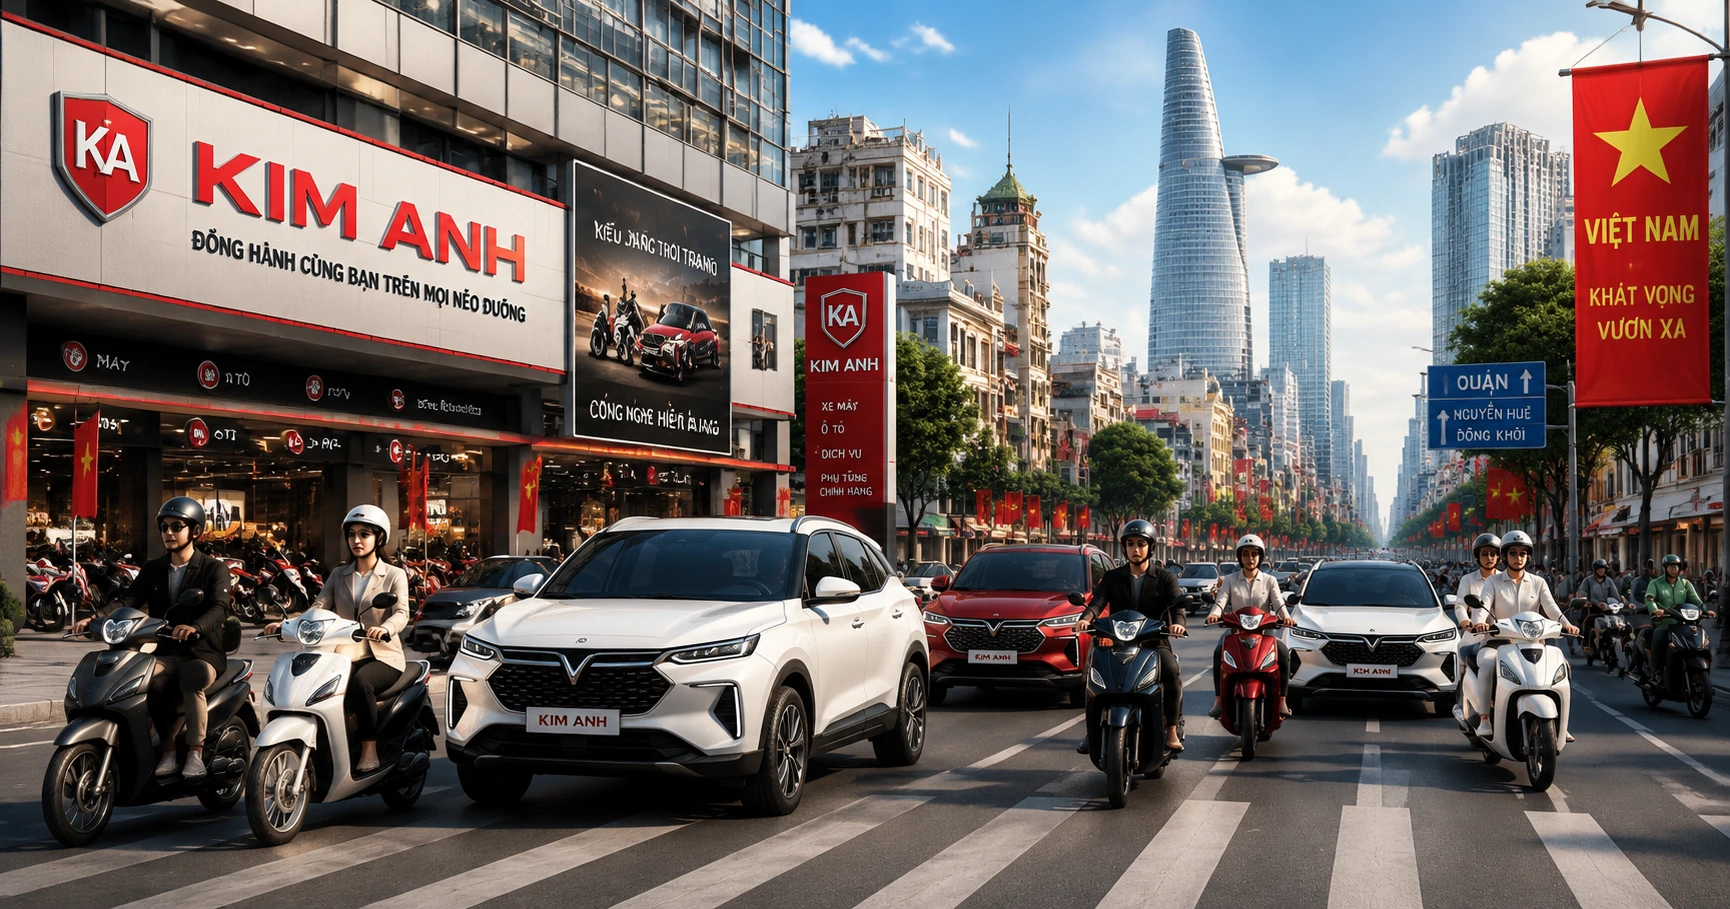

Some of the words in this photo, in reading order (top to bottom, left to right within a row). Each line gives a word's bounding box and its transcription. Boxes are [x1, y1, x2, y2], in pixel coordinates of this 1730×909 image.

[75, 119, 140, 184] KA
[192, 140, 358, 241] KIM
[379, 200, 526, 284] ANH
[1584, 212, 1637, 250] VIỆT
[1645, 214, 1700, 242] NAM
[348, 266, 379, 292] BẠN
[424, 284, 449, 308] MỌI
[1589, 282, 1637, 307] KHÁT
[1645, 283, 1696, 309] VỌNG
[828, 304, 860, 327] KA
[1597, 317, 1653, 341] VƯƠN
[1659, 317, 1687, 339] XA
[810, 359, 839, 373] KIM
[843, 357, 879, 372] ANH
[821, 401, 834, 412] XE
[821, 419, 829, 435] Ô
[832, 420, 845, 434] TÔ
[821, 448, 845, 460] DICH
[538, 714, 568, 726] KIM
[573, 715, 607, 728] ANH
